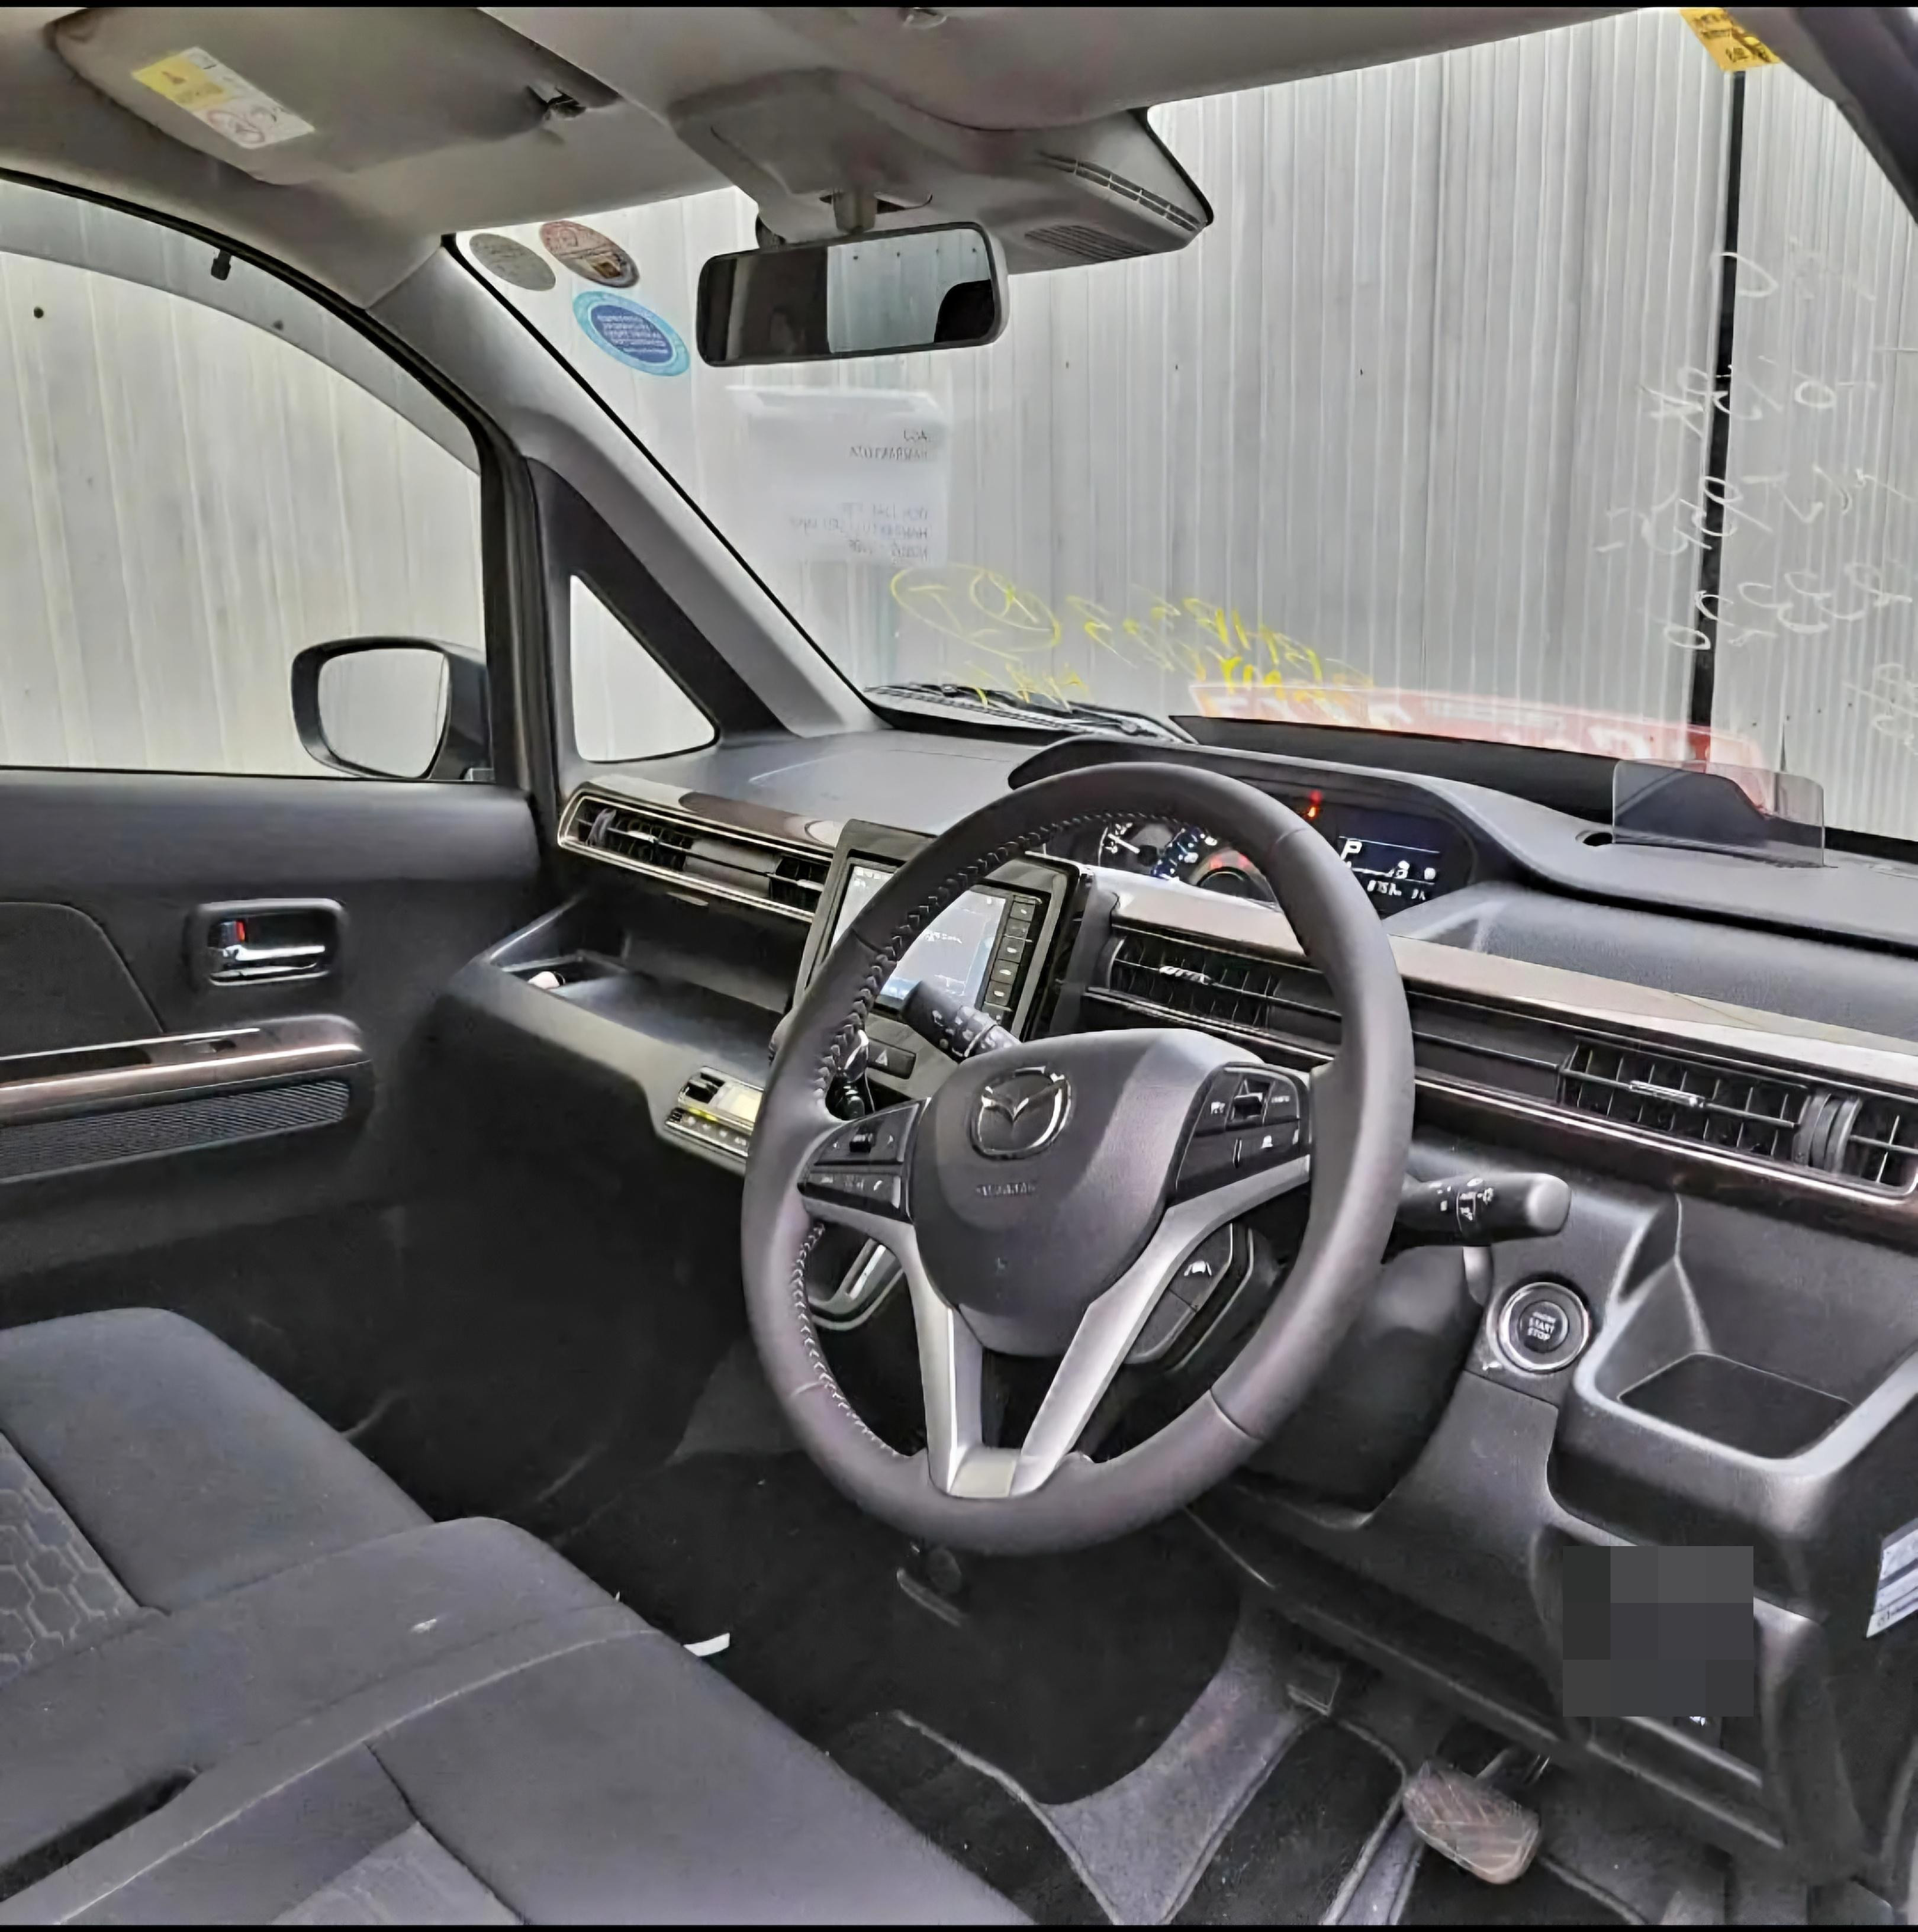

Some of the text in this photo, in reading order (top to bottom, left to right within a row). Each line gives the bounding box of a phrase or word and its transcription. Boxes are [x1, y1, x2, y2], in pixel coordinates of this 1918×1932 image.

[1341, 838, 1362, 861] P
[1527, 1327, 1551, 1341] STOP
[1528, 1317, 1555, 1334] START
